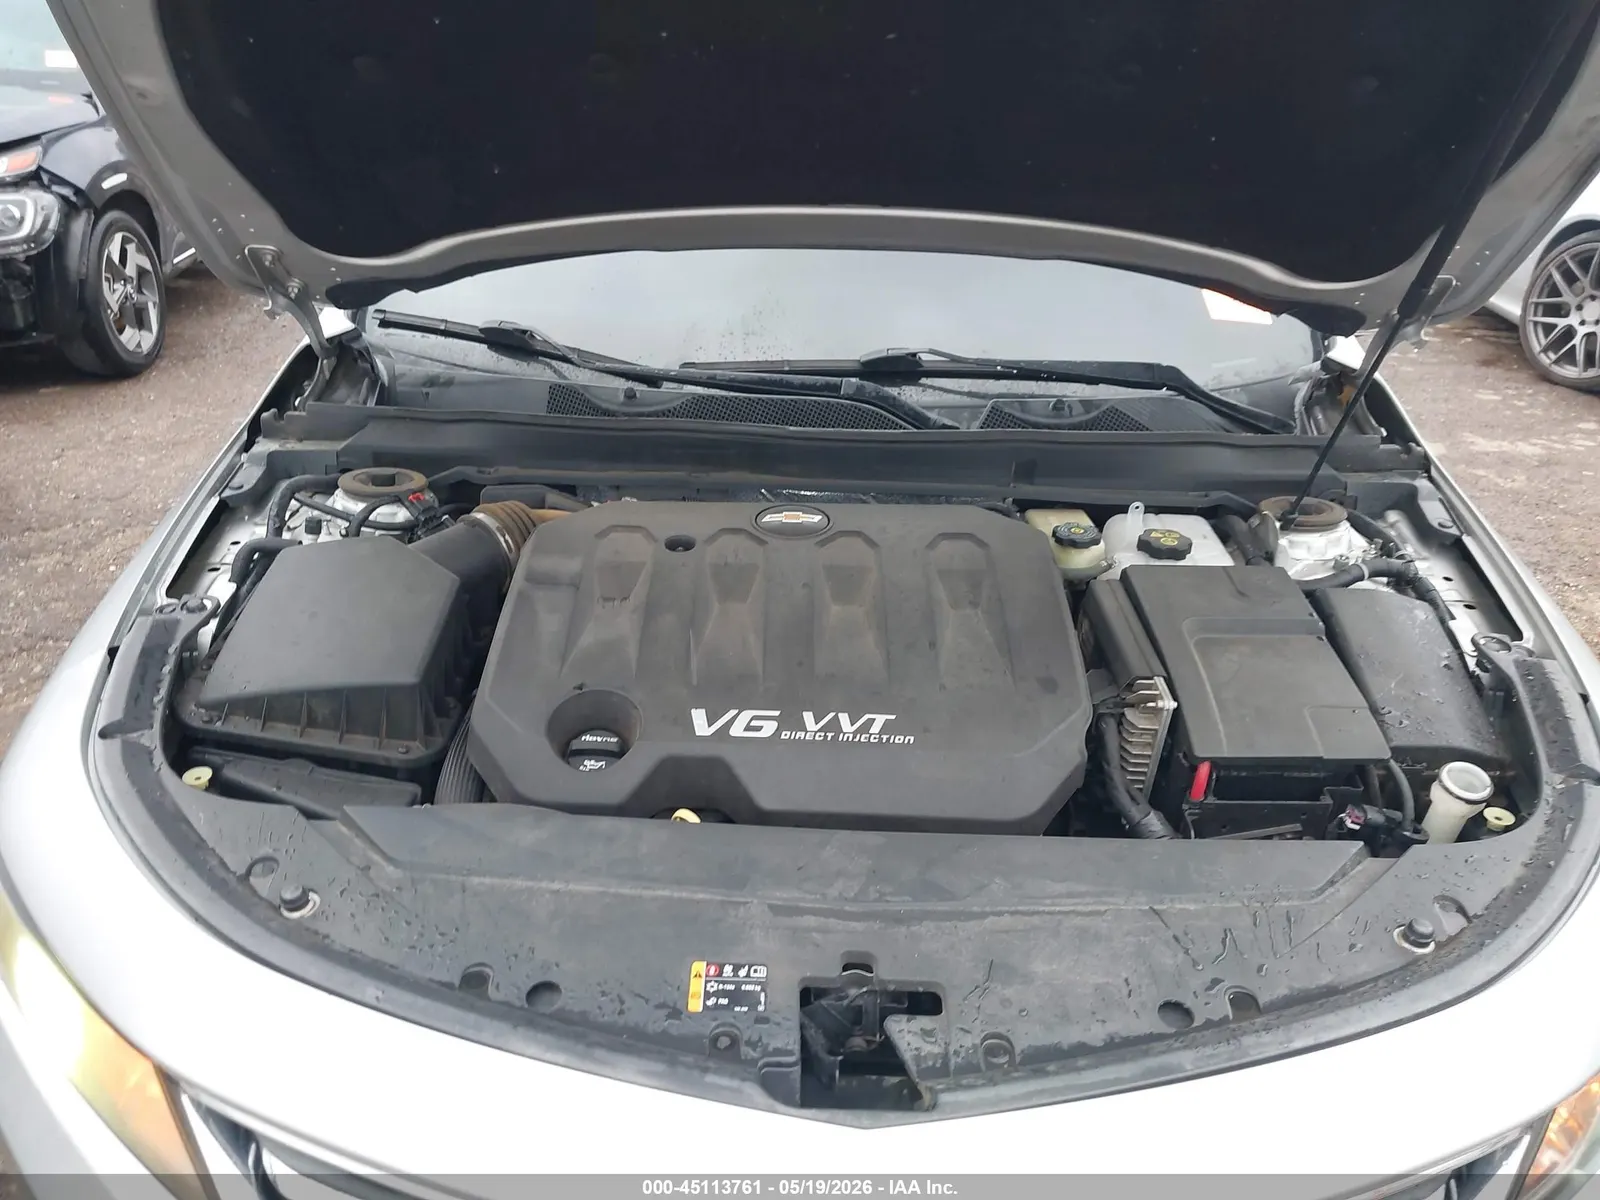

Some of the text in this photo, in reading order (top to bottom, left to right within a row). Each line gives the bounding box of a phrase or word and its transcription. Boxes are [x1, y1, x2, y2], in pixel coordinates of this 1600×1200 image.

[691, 707, 896, 738] V6 VVT
[780, 730, 915, 744] DIRECT INJECTION
